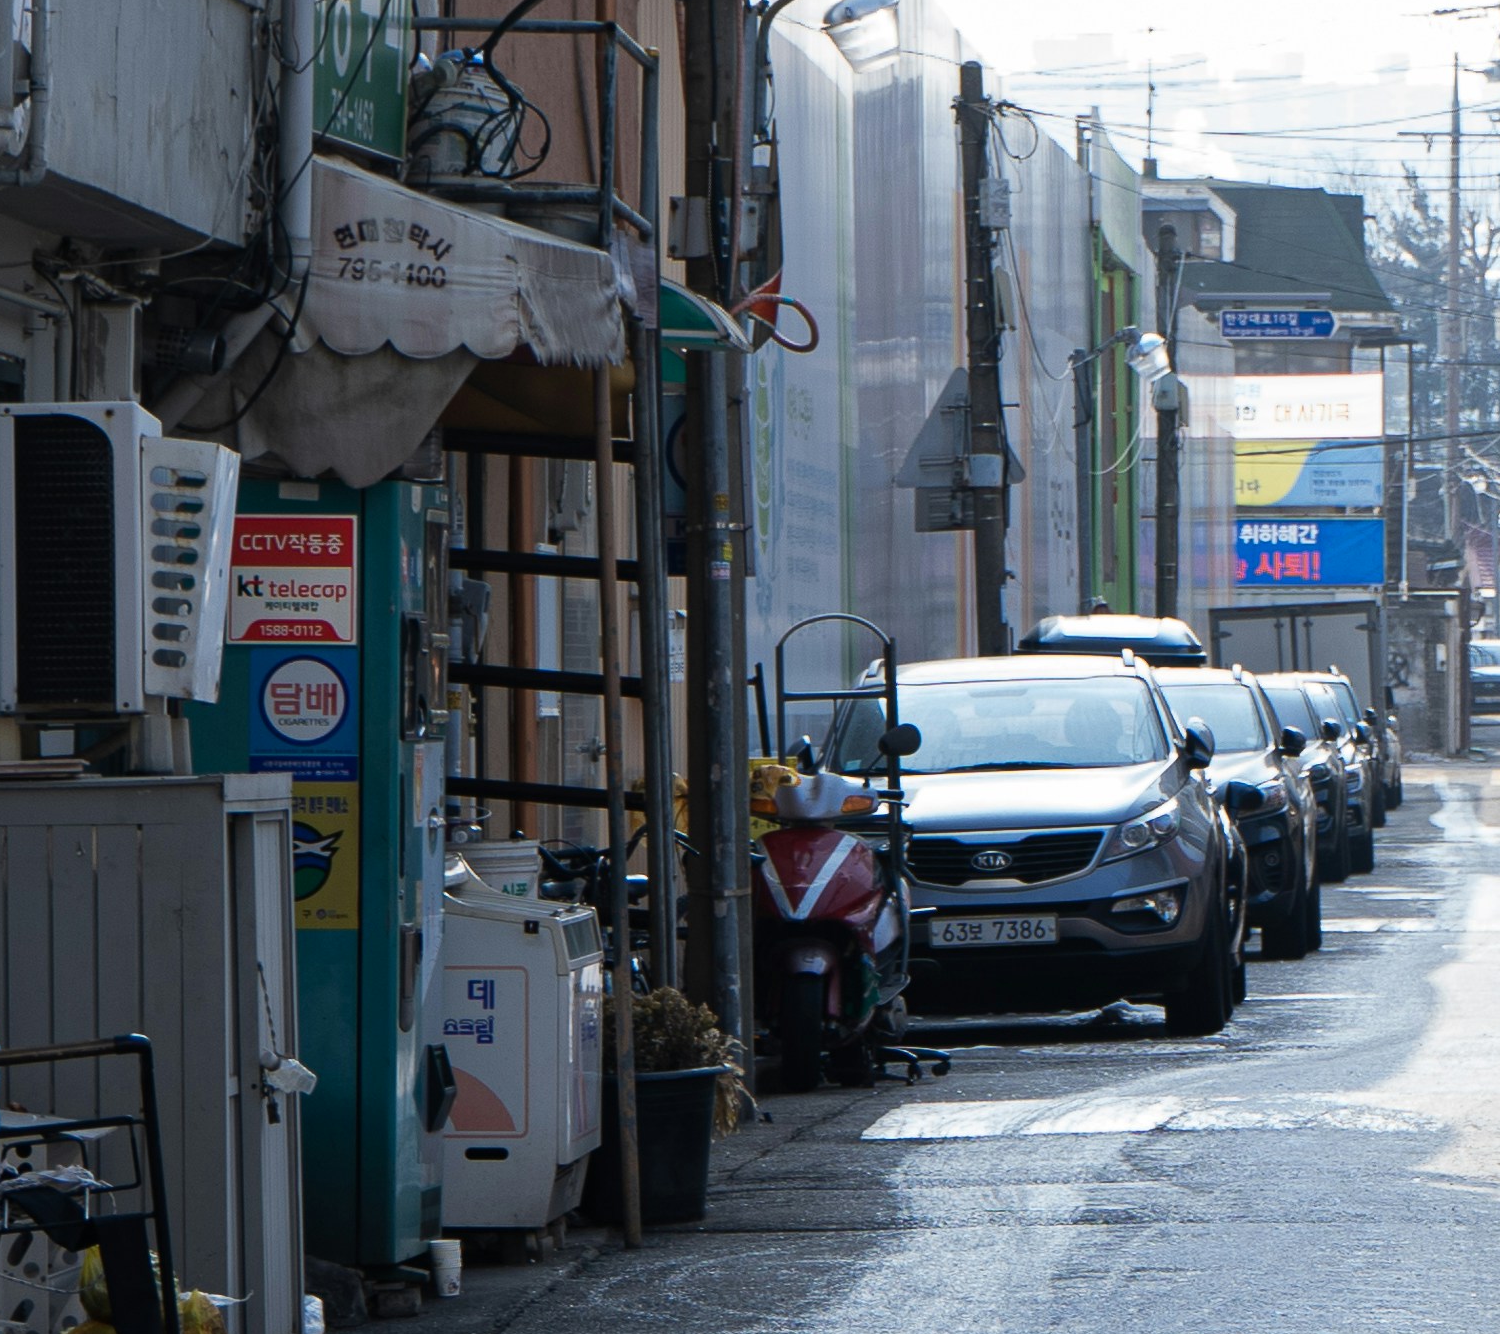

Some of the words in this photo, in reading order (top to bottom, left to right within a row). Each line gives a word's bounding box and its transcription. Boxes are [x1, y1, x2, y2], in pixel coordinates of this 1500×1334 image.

[239, 533, 345, 555] CCTV작동중
[237, 574, 264, 598] kt
[268, 579, 348, 603] telecop
[259, 624, 324, 637] 1588-0112
[270, 682, 338, 716] 담배
[977, 855, 1008, 867] KIA
[942, 922, 984, 943] 63보
[991, 919, 1047, 941] 7386
